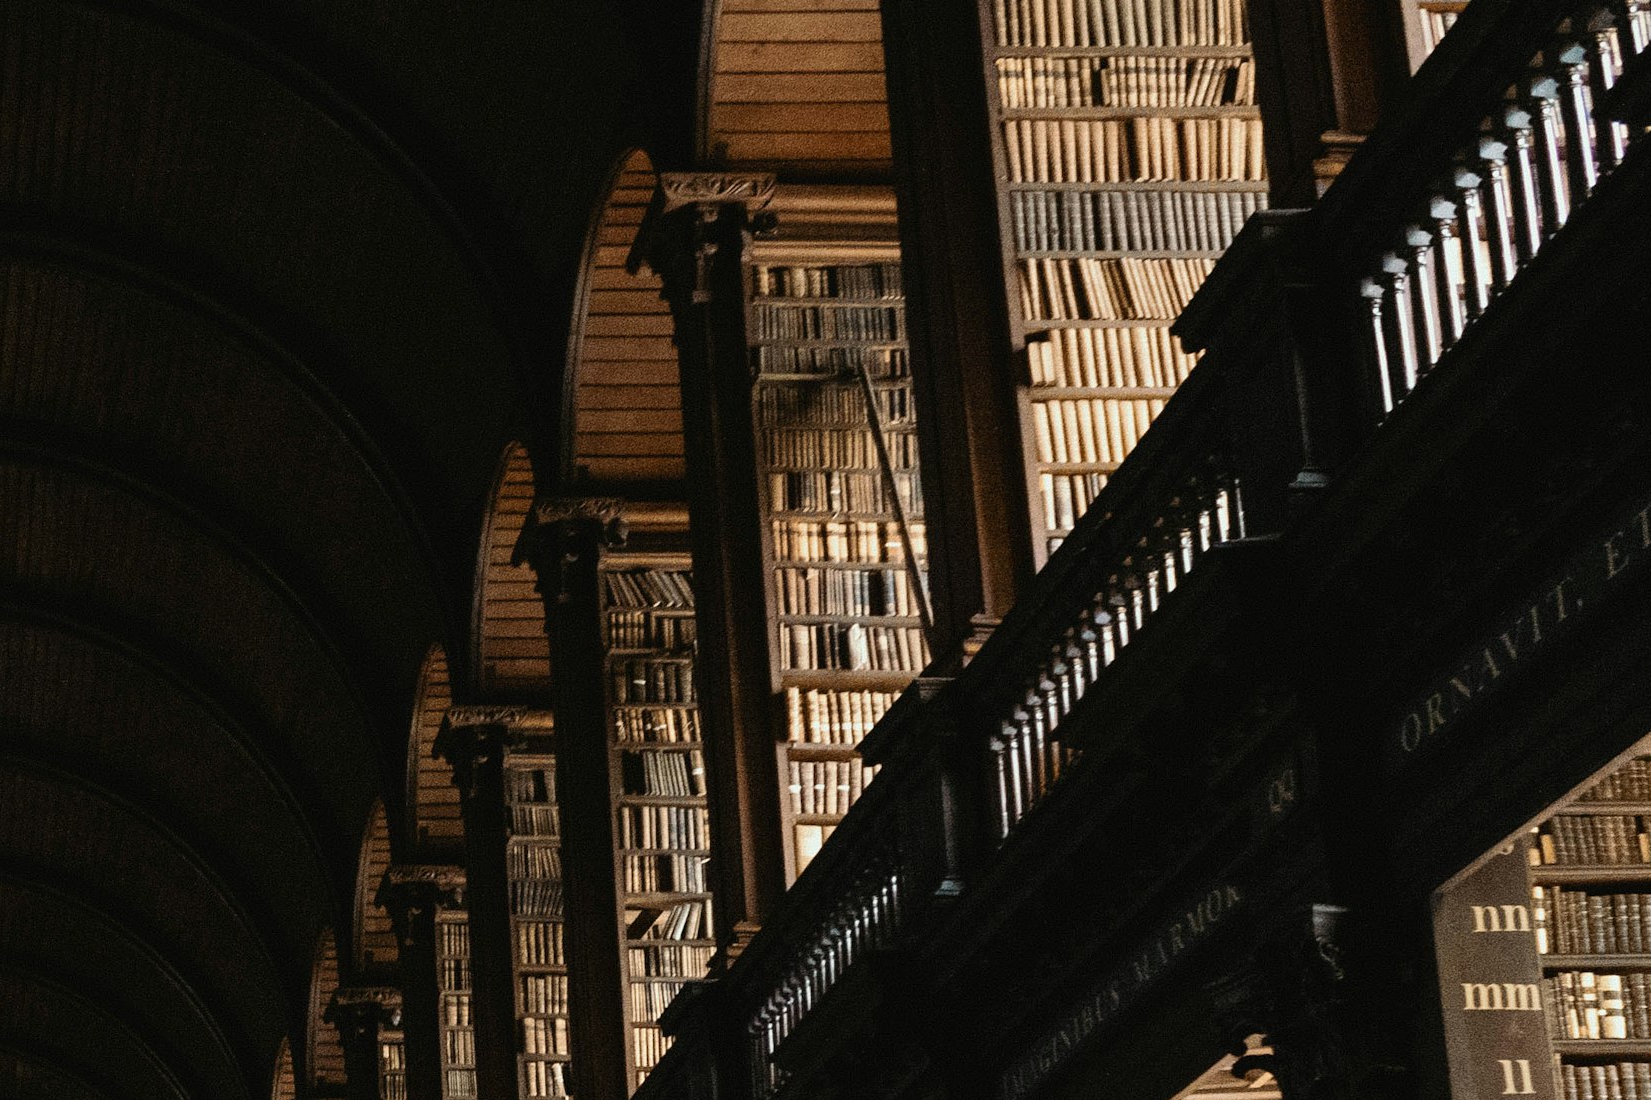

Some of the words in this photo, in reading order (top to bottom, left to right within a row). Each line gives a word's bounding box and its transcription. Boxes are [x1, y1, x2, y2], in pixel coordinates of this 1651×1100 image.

[1401, 576, 1583, 752] ORNAVIT.
[1472, 905, 1530, 932] nn
[1463, 984, 1542, 1011] mm
[1499, 1060, 1535, 1094] ll
